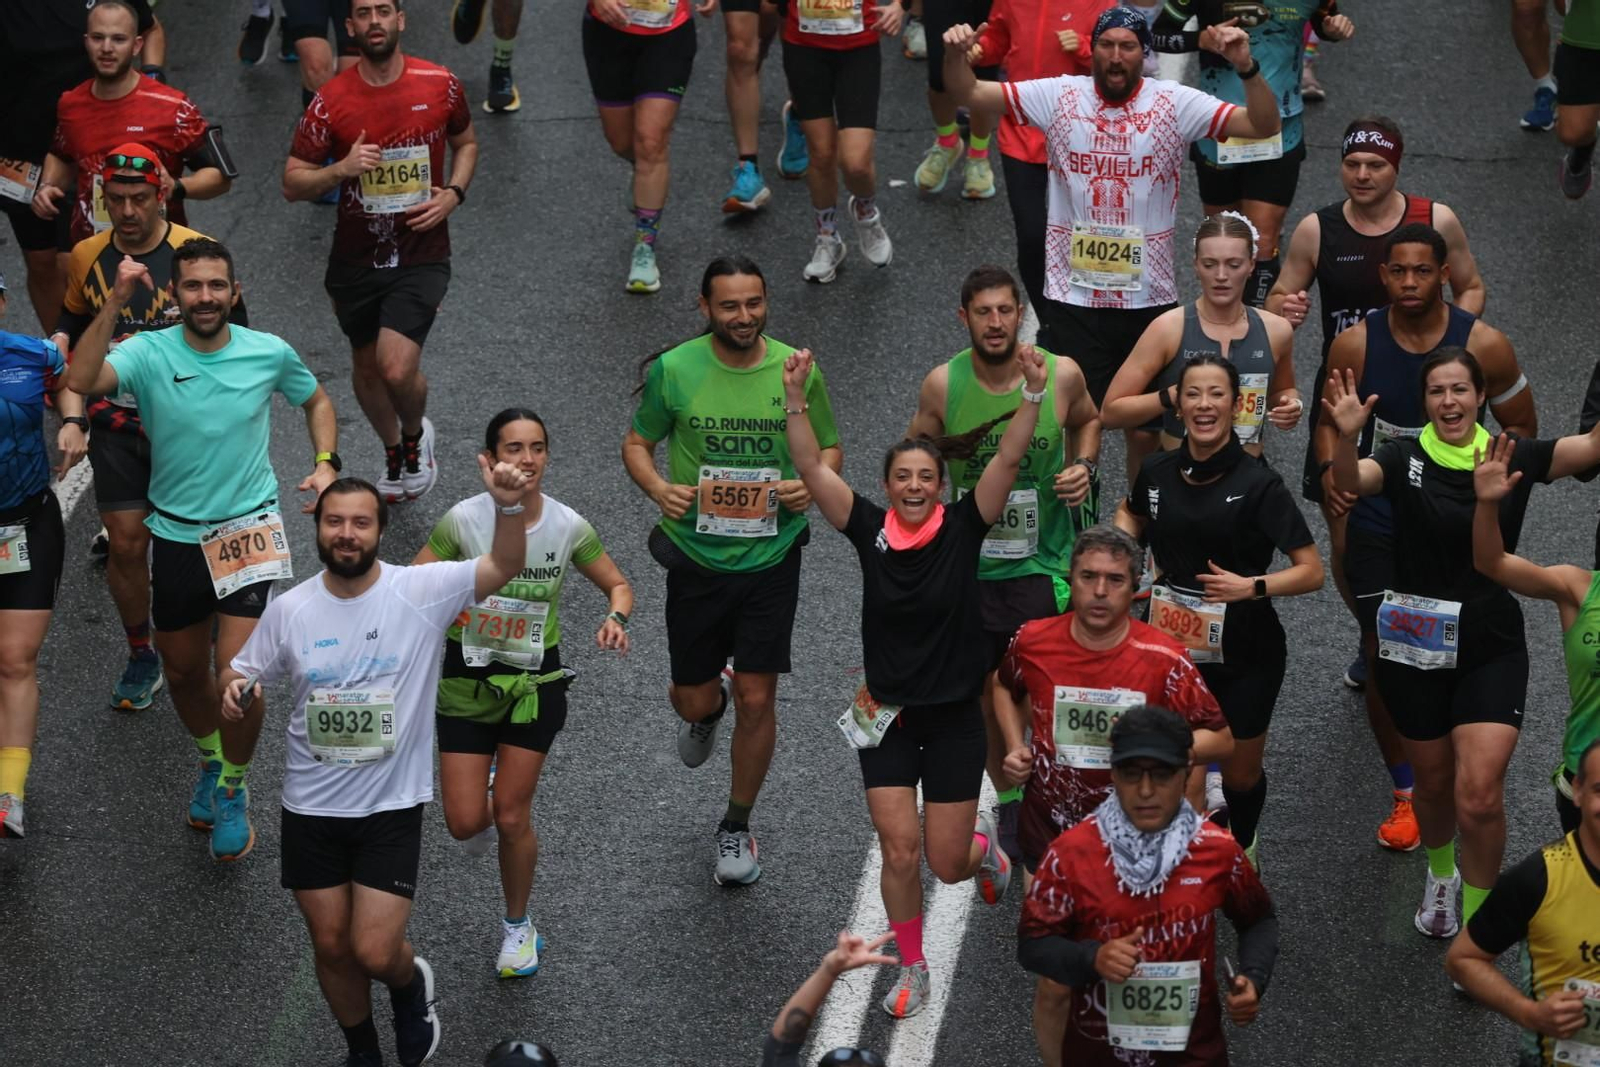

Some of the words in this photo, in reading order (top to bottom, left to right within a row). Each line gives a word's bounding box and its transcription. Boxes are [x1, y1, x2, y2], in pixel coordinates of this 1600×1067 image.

[1355, 130, 1368, 143] &
[1369, 131, 1394, 150] Run
[365, 162, 420, 186] 12164
[1069, 151, 1153, 177] SEVILLA
[1077, 238, 1131, 262] 14024
[705, 435, 774, 454] sano
[980, 434, 1049, 450] RUNG
[711, 486, 762, 507] 5567
[219, 532, 266, 562] 4870
[518, 566, 561, 580] NNING
[500, 582, 548, 598] ano
[477, 613, 526, 640] 7318
[1159, 606, 1203, 638] 3892
[314, 638, 340, 649] HOKA
[318, 710, 374, 733] 9932
[1068, 707, 1120, 733] 846
[1122, 985, 1183, 1011] 6825
